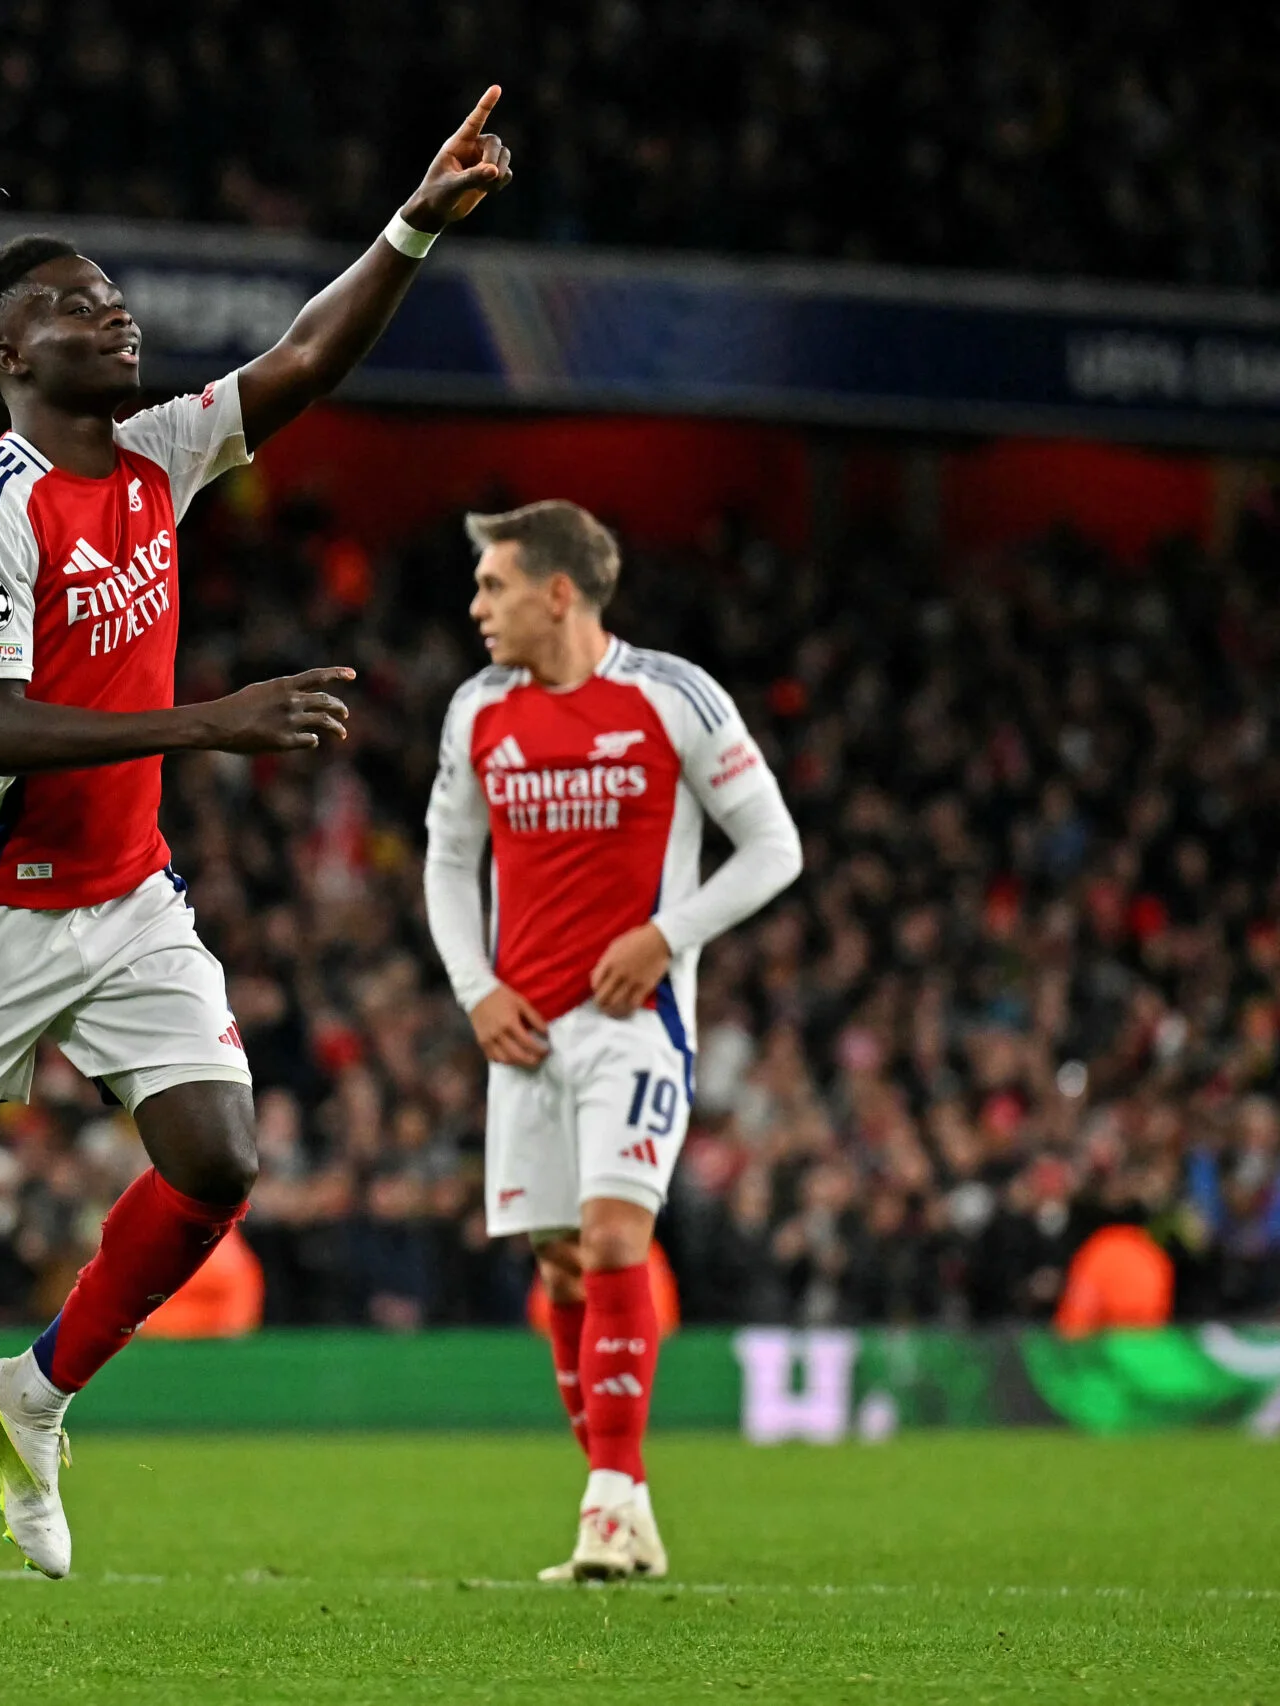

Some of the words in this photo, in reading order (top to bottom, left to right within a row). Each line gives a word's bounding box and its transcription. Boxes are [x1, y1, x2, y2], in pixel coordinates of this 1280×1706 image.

[66, 529, 171, 626] Emiates
[90, 616, 123, 656] FLY
[486, 766, 647, 804] Emirates
[627, 1070, 677, 1135] 19
